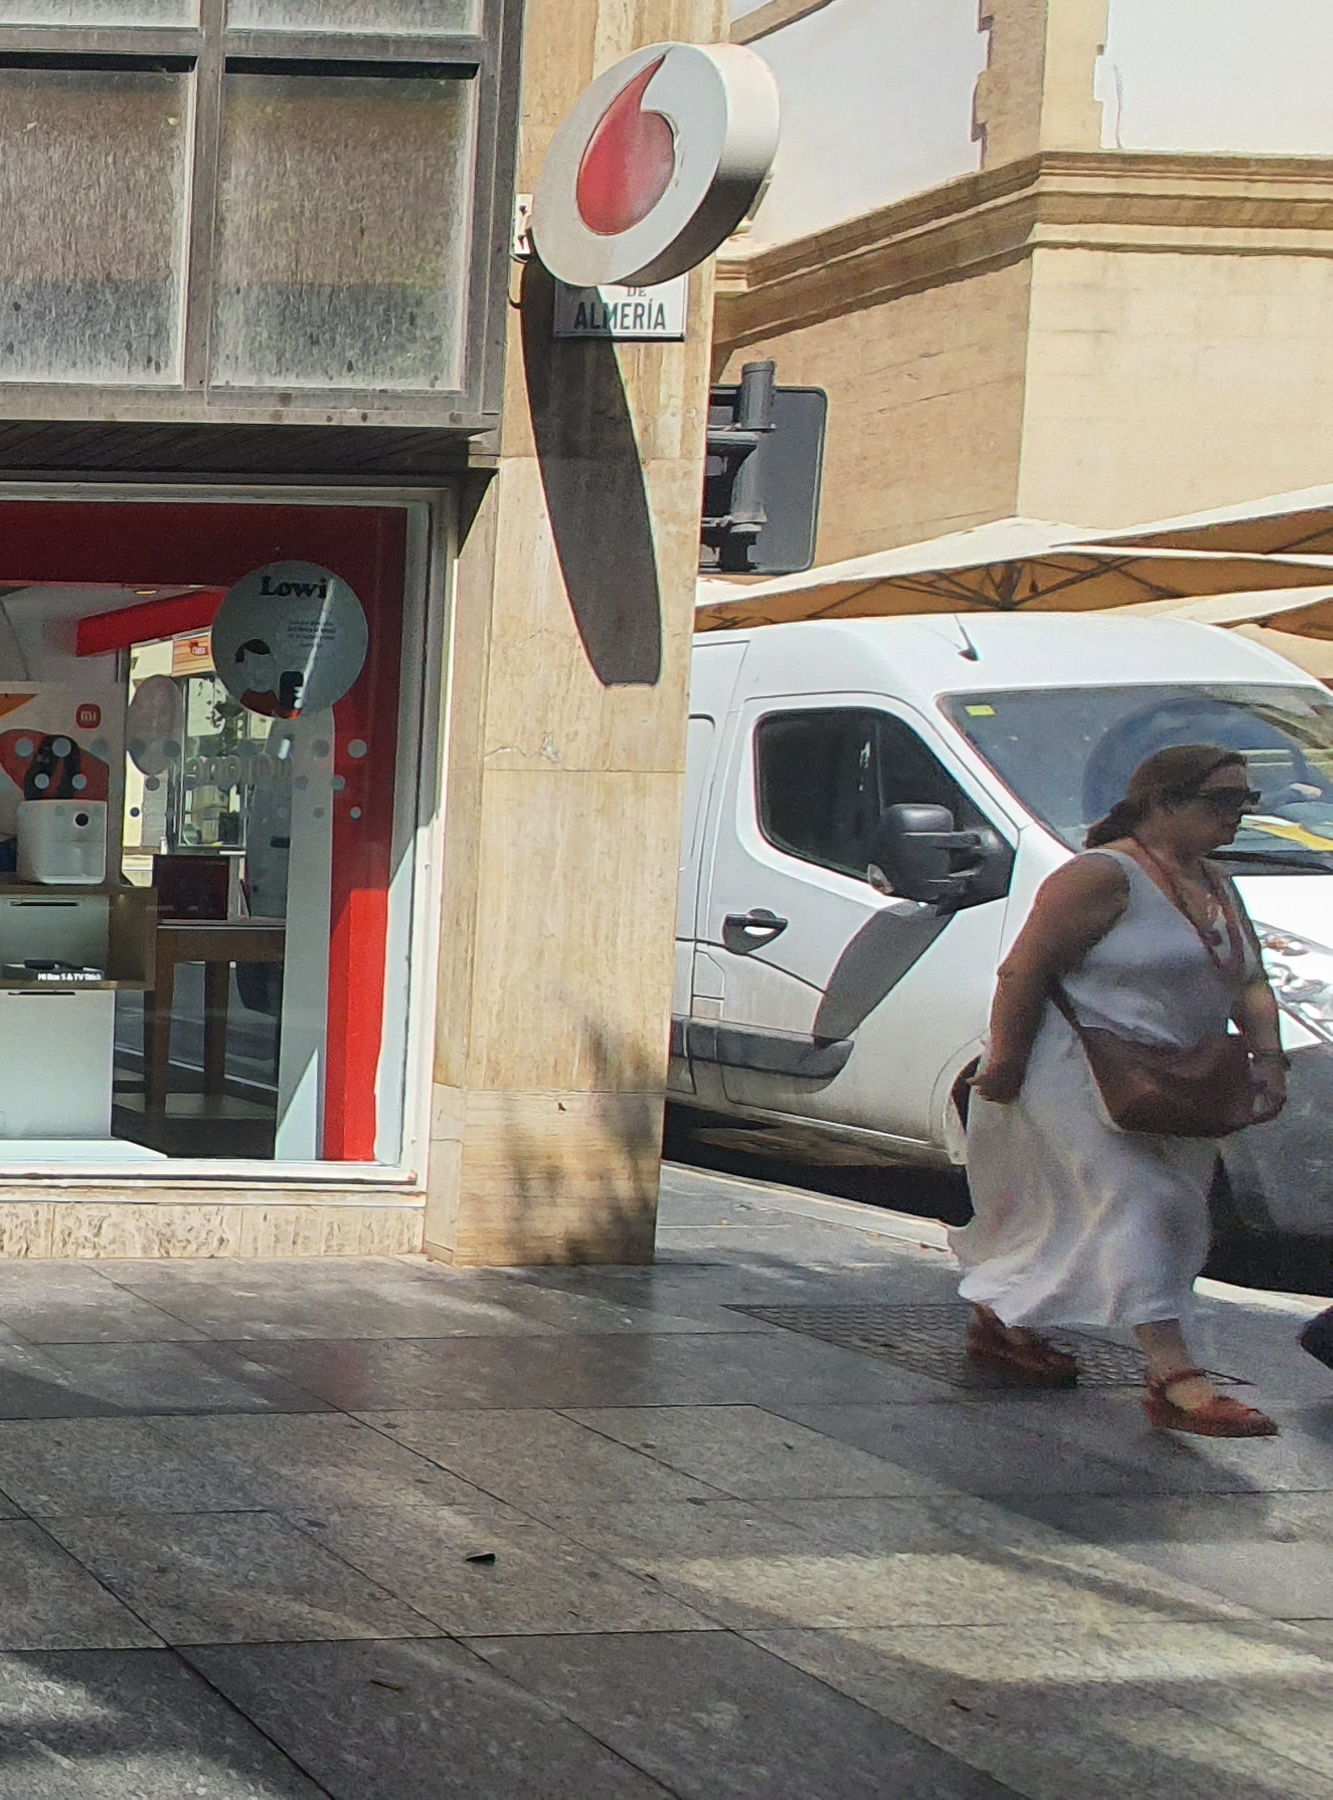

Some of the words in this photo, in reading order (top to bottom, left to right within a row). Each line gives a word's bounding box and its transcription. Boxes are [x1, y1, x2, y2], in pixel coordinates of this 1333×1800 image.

[627, 287, 647, 297] DE
[573, 299, 666, 330] ALMERÍA
[261, 576, 327, 599] Lowi
